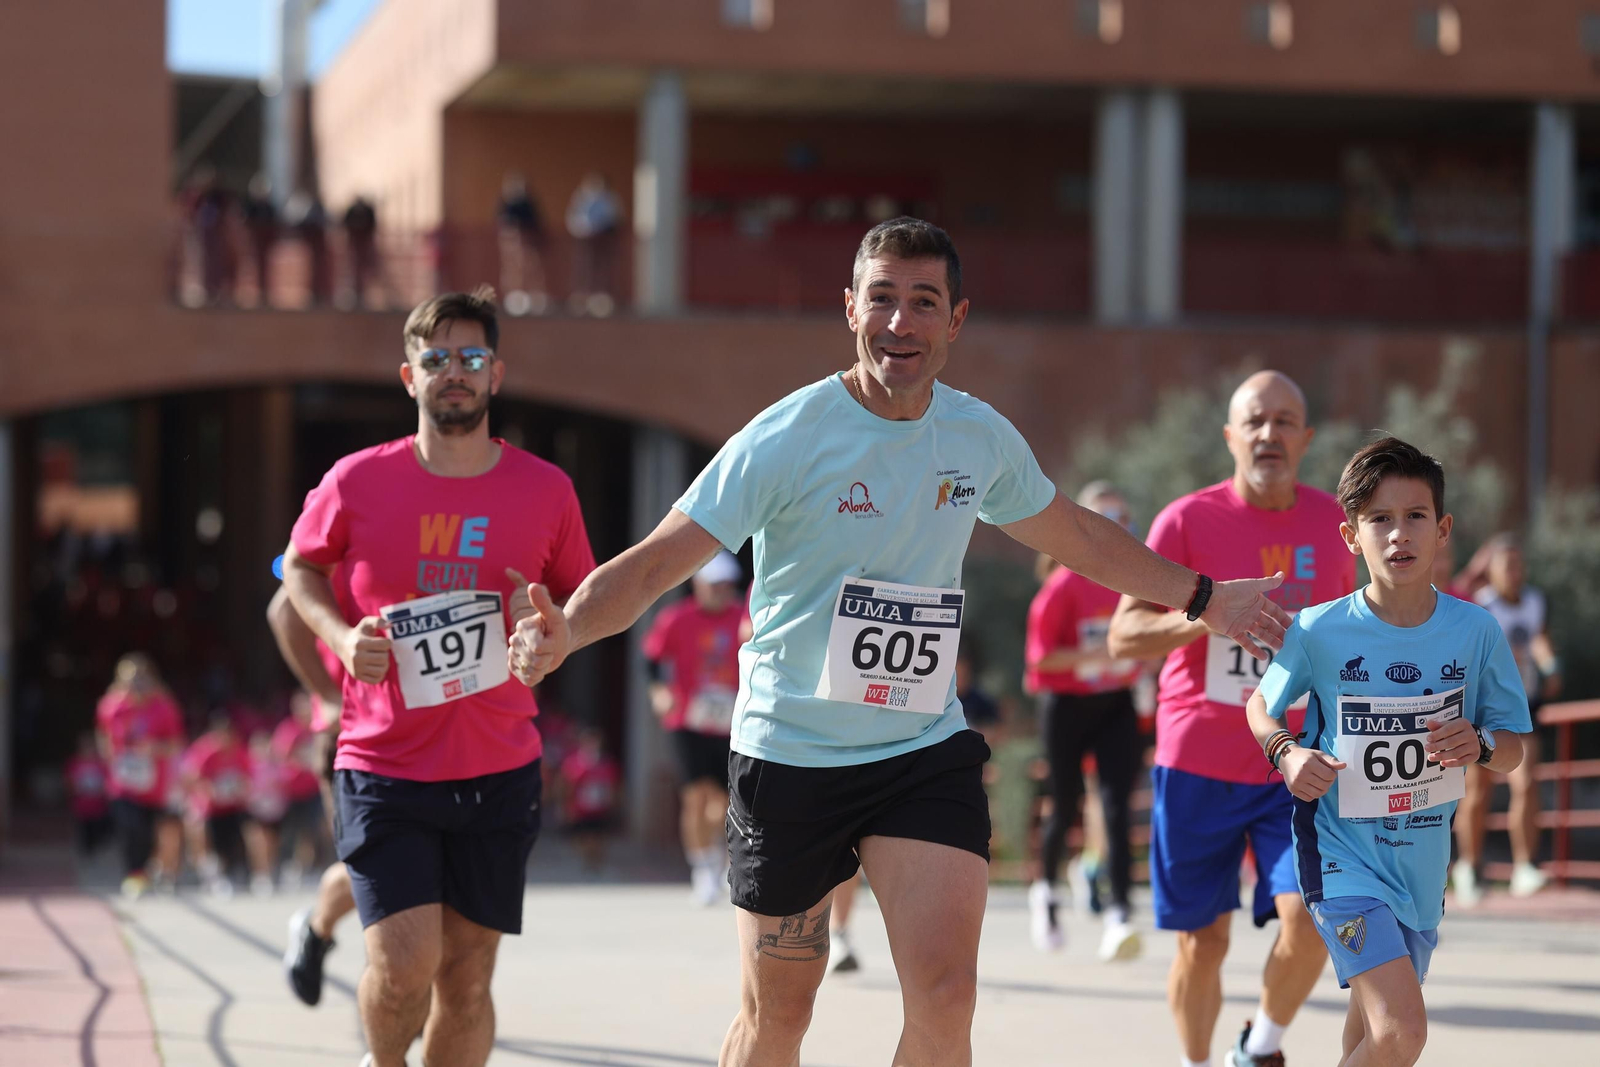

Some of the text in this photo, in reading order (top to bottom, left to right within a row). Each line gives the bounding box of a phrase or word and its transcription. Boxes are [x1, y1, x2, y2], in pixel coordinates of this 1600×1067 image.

[419, 513, 489, 558] WE
[1260, 544, 1316, 580] WE
[420, 562, 476, 593] RUN
[877, 587, 899, 595] CARRERA
[876, 593, 912, 603] UNIVERSIDAD
[845, 598, 903, 621] UMA
[393, 614, 445, 636] UMA
[414, 621, 486, 676] 197
[852, 626, 941, 676] 605
[1340, 669, 1370, 677] CUEVA
[1387, 666, 1420, 680] TROPS
[867, 688, 889, 700] WE
[891, 686, 910, 695] RUN
[888, 698, 908, 707] RUN
[1345, 716, 1406, 732] UMA
[1412, 788, 1429, 796] RUN
[1389, 796, 1411, 808] WE
[1412, 800, 1428, 808] RUN
[1411, 814, 1443, 823] BFwork
